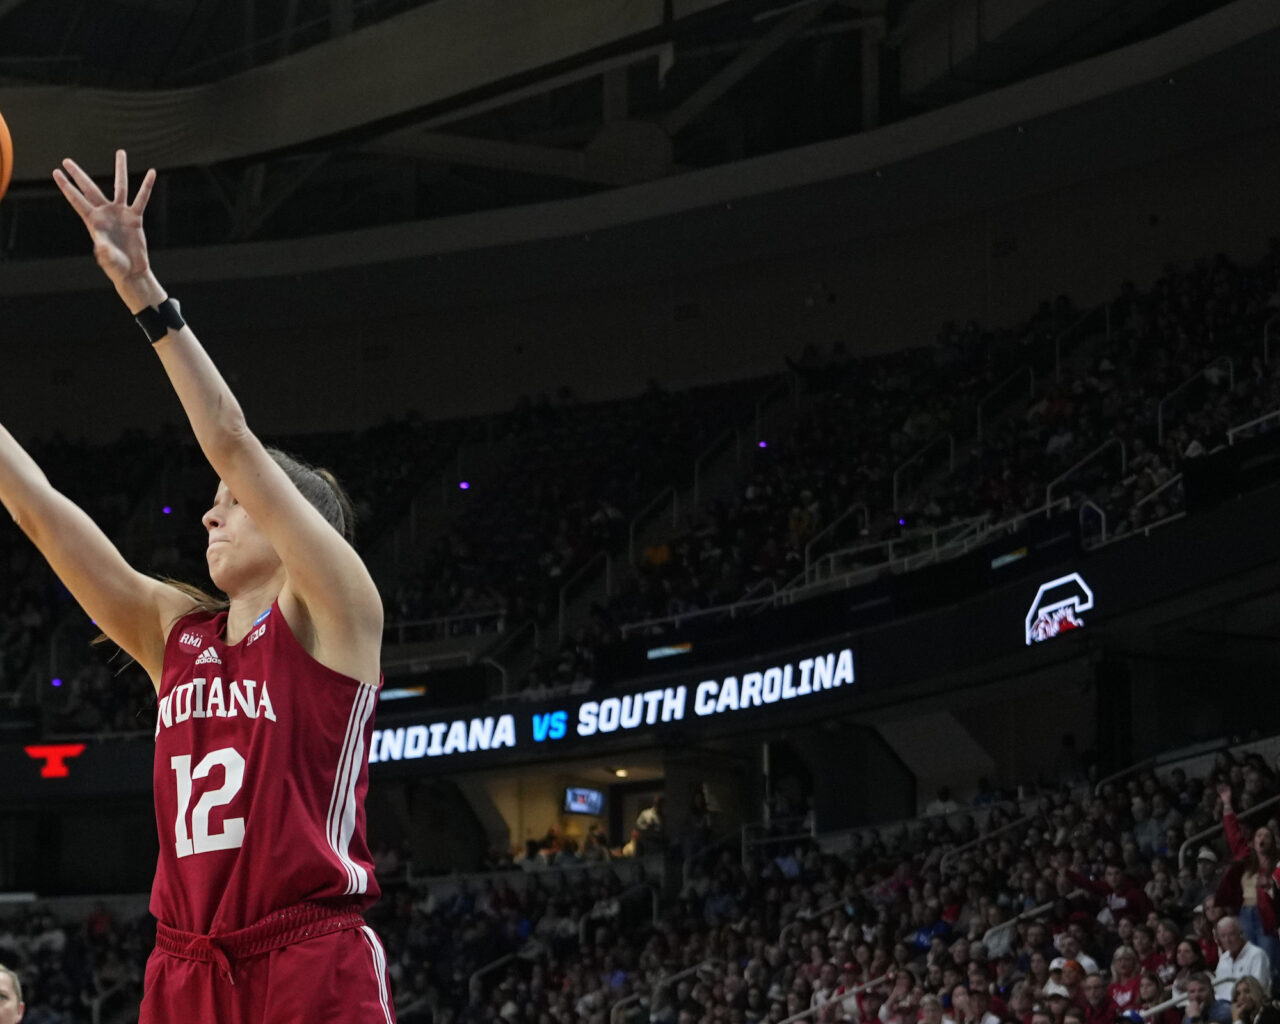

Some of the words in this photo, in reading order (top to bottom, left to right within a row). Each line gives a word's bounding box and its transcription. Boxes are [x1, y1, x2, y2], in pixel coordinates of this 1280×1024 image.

[195, 656, 222, 665] adidas
[155, 676, 277, 741] NDIANA
[369, 715, 516, 763] INDIANA
[532, 711, 568, 742] VS
[577, 686, 686, 736] SOUTH
[694, 649, 855, 717] CAROLINA
[171, 747, 245, 858] 12
